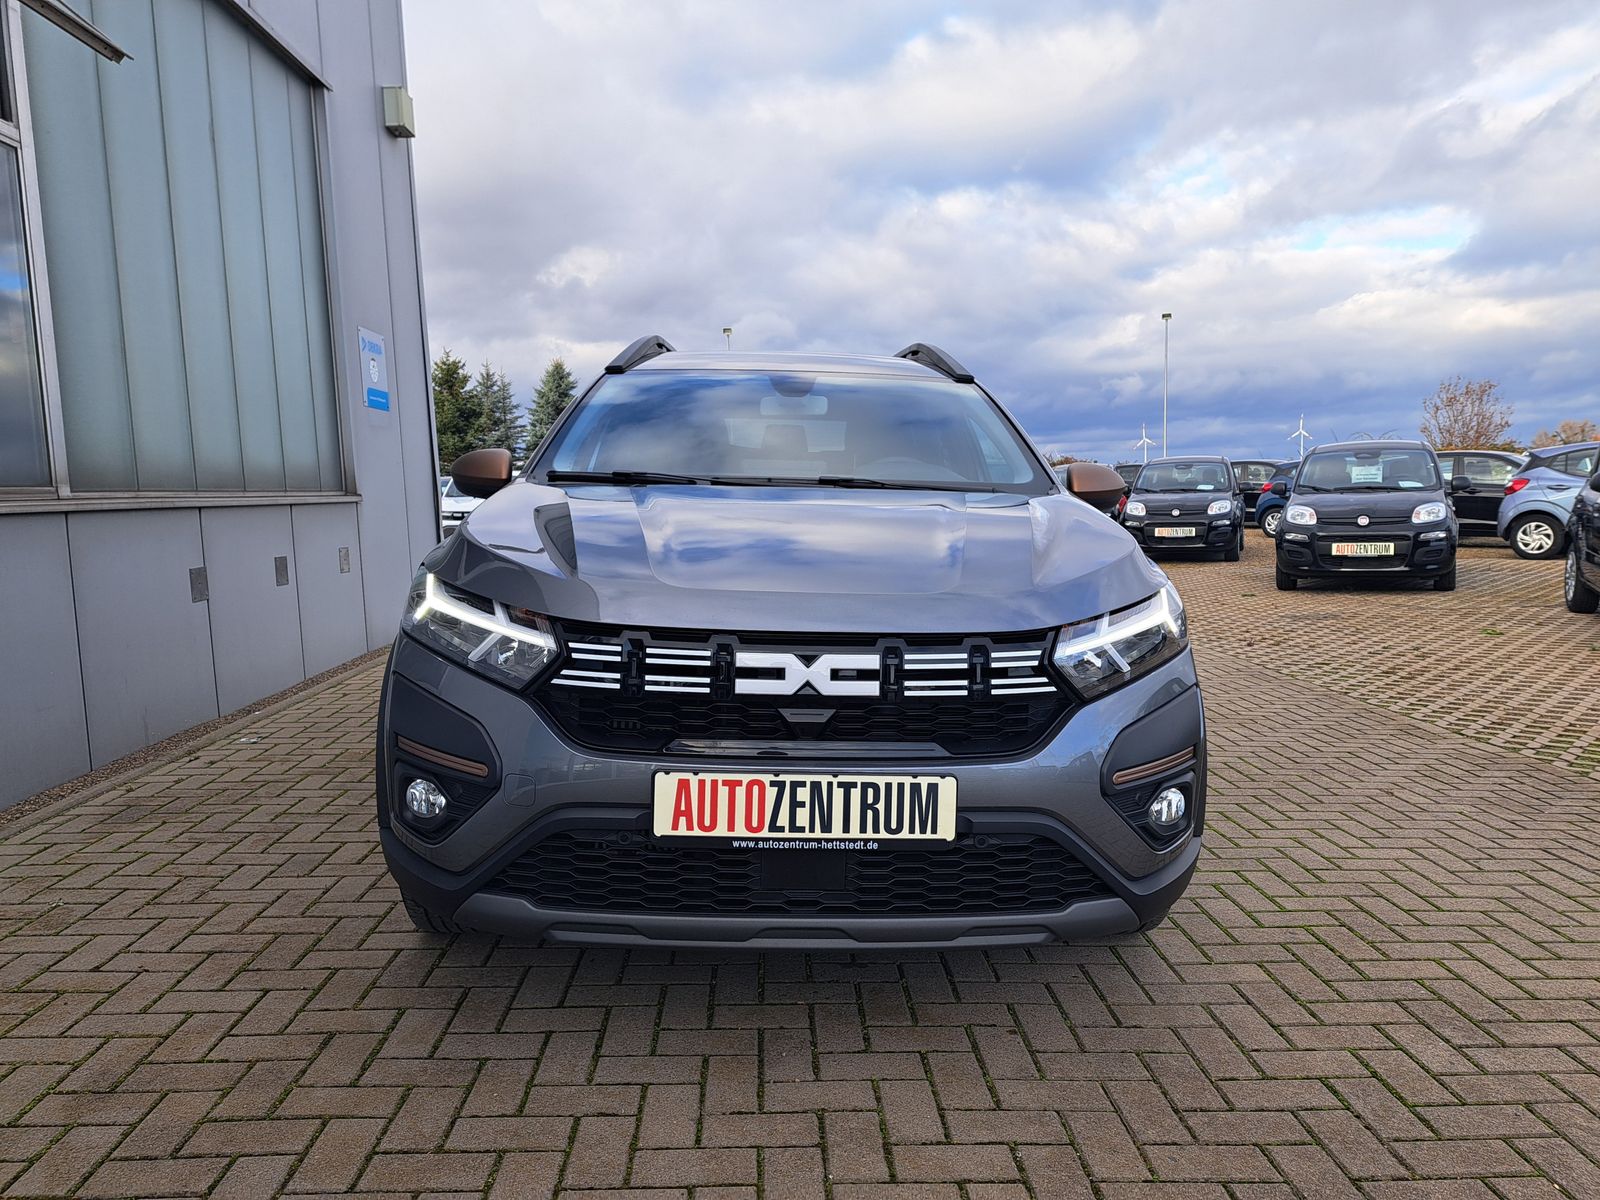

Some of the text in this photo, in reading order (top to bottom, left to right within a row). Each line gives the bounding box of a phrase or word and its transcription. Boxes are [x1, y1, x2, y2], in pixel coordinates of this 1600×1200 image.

[1157, 528, 1193, 536] AUTOZENTRUM
[1335, 543, 1391, 554] AUTOZENTRUM
[670, 777, 940, 836] AUTOZENTRUM
[732, 839, 879, 850] www.autozentrum-hettstedt.de
